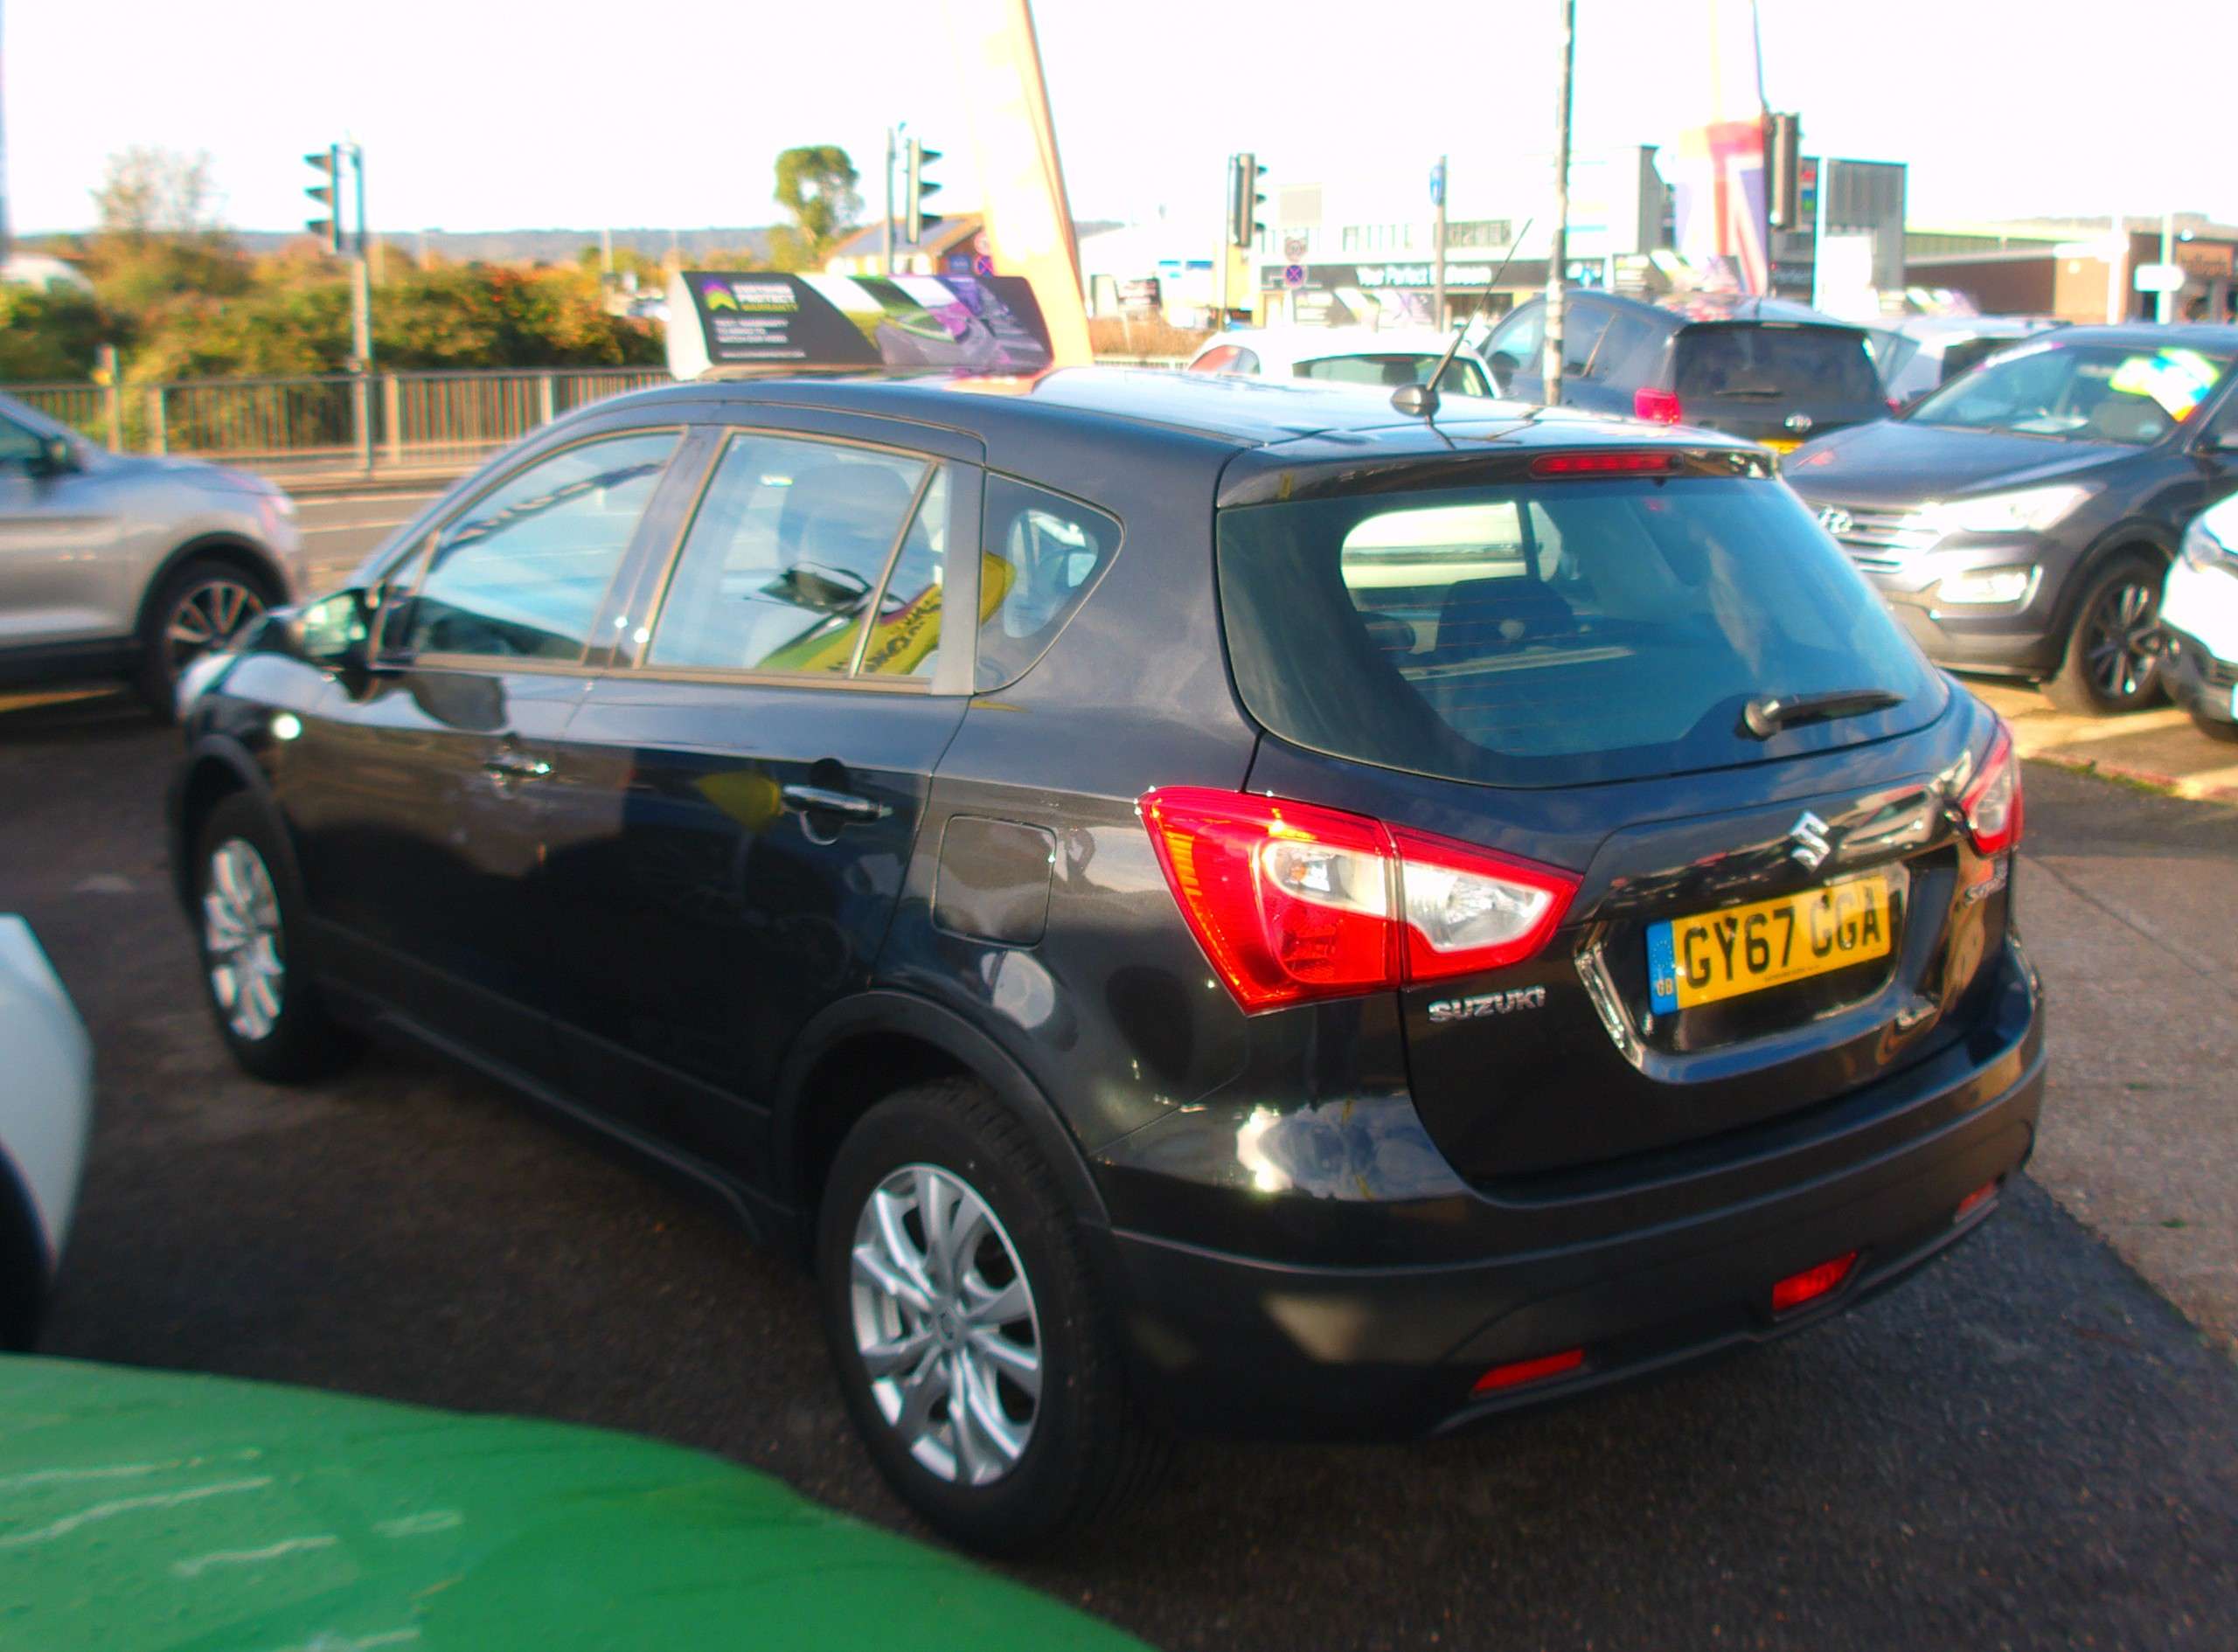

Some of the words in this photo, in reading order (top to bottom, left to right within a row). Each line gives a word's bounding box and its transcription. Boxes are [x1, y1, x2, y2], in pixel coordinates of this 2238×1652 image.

[1684, 906, 1795, 989] GY67
[1810, 886, 1880, 958] CGA
[1428, 985, 1546, 1022] SUZUKI
